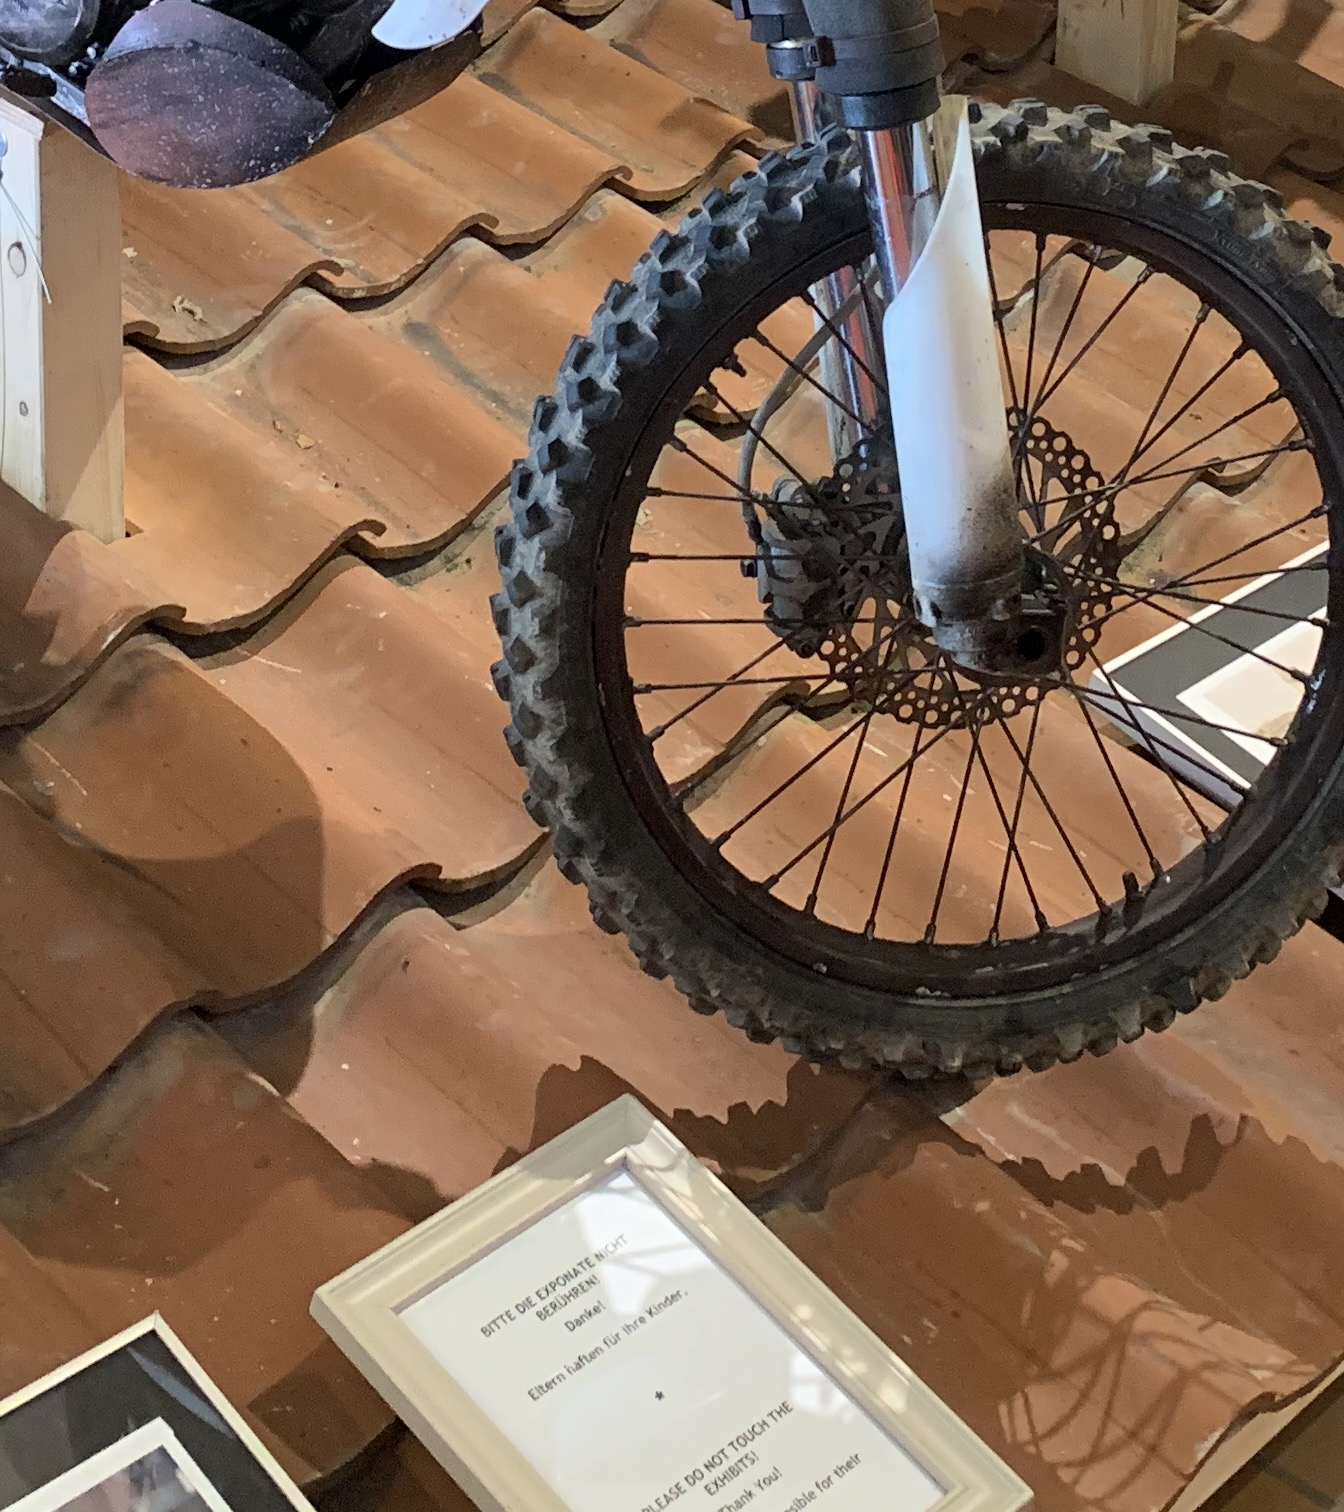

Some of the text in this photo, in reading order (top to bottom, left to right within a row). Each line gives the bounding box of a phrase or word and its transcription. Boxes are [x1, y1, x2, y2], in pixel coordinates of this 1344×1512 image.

[480, 1234, 629, 1338] BITTE DIE EXPONATE NICHT
[535, 1274, 601, 1322] BERÜHREN!
[564, 1300, 607, 1332] Danke!
[527, 1371, 567, 1402] Eltern
[564, 1345, 604, 1376] haften
[603, 1331, 622, 1350] für
[684, 1470, 706, 1488] DO
[703, 1448, 730, 1473] NOT
[728, 1418, 771, 1452] TOUCH
[767, 1400, 794, 1423] THE
[703, 1451, 760, 1497] EXHIBITS!
[754, 1466, 783, 1492] You!
[815, 1475, 835, 1494] for
[833, 1453, 862, 1479] their
